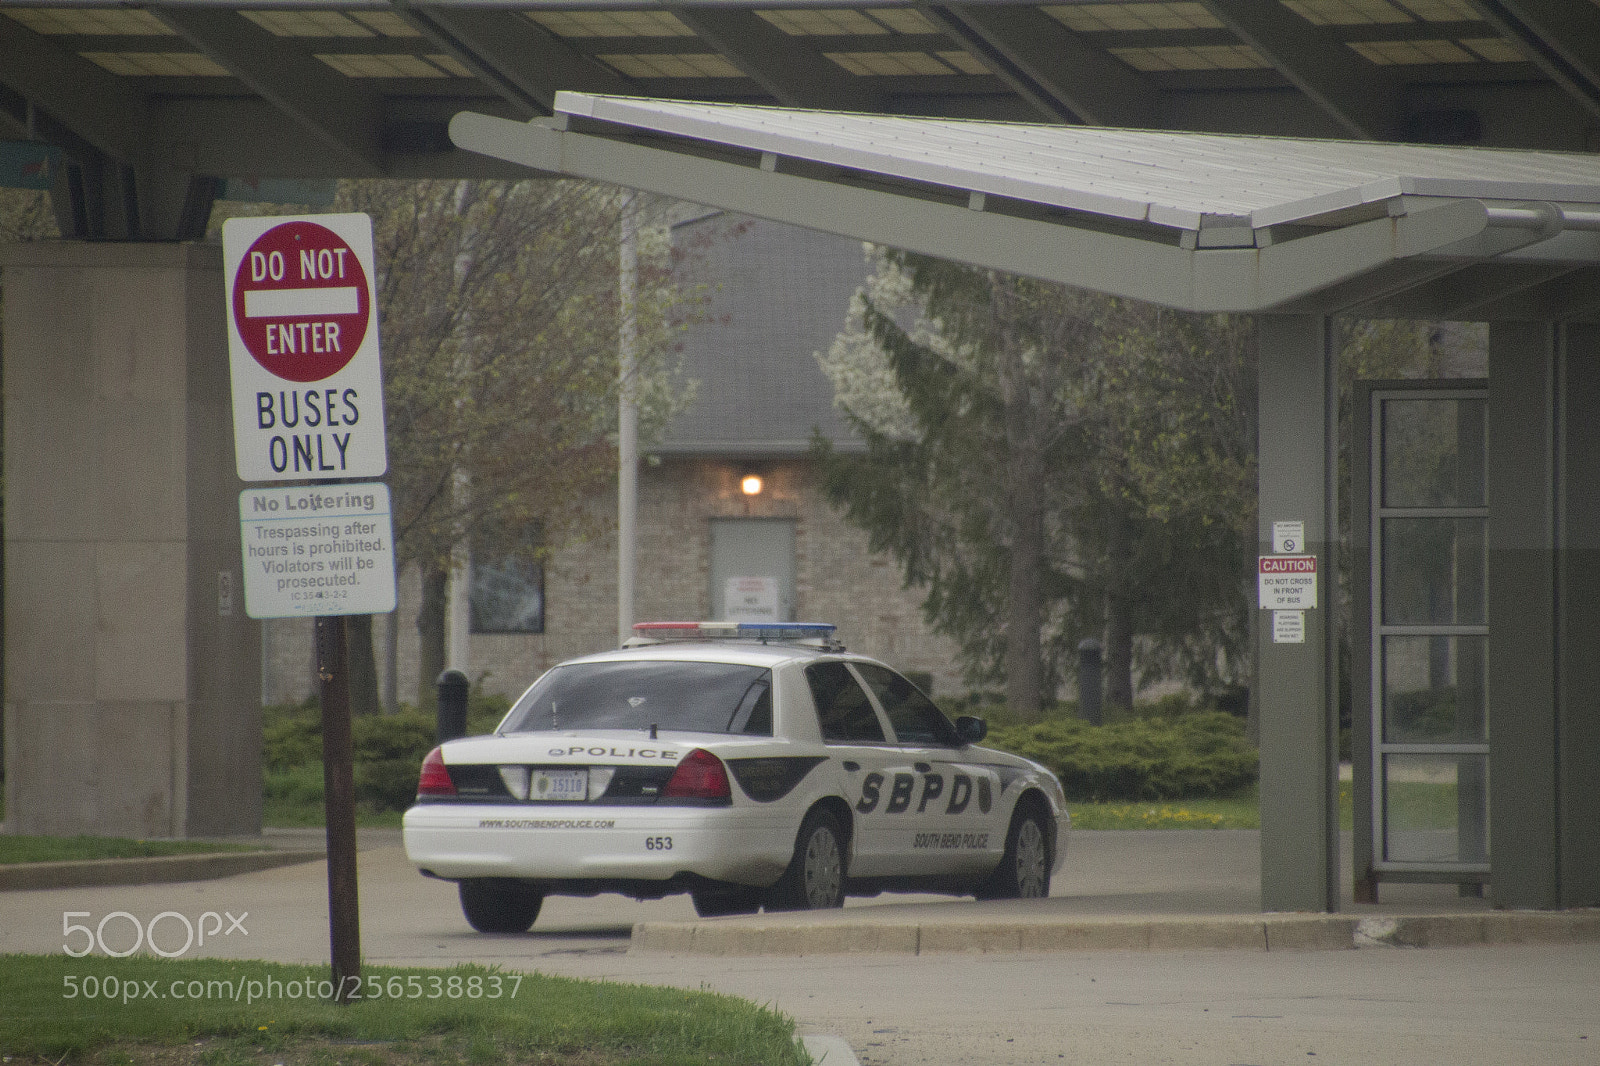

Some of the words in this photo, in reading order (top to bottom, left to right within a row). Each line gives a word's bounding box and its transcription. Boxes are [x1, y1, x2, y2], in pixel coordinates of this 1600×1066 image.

[251, 250, 285, 282] DO
[300, 248, 347, 280] NOT
[266, 322, 341, 354] ENTER
[256, 388, 359, 429] BUSES
[269, 433, 351, 473] ONLY
[252, 496, 279, 512] No
[285, 492, 375, 511] Loitering
[255, 523, 340, 540] Trespassing
[344, 521, 376, 535] after
[249, 543, 288, 557] hours
[293, 542, 305, 555] is
[309, 538, 386, 557] prohibited.
[262, 559, 324, 574] Violators
[328, 558, 352, 571] will
[356, 556, 374, 570] be
[1263, 560, 1314, 571] CAUTION
[277, 572, 361, 592] prosecuted.
[1264, 578, 1274, 586] DO
[1273, 587, 1280, 595] IN
[568, 746, 679, 760] POLICE
[855, 772, 972, 815] SBPD
[478, 818, 615, 830] WWW.SOUTHBENDPOLICE.COM
[645, 836, 673, 850] 653
[913, 833, 940, 849] SOUTH
[940, 833, 962, 849] BEND
[961, 833, 989, 849] POLICE
